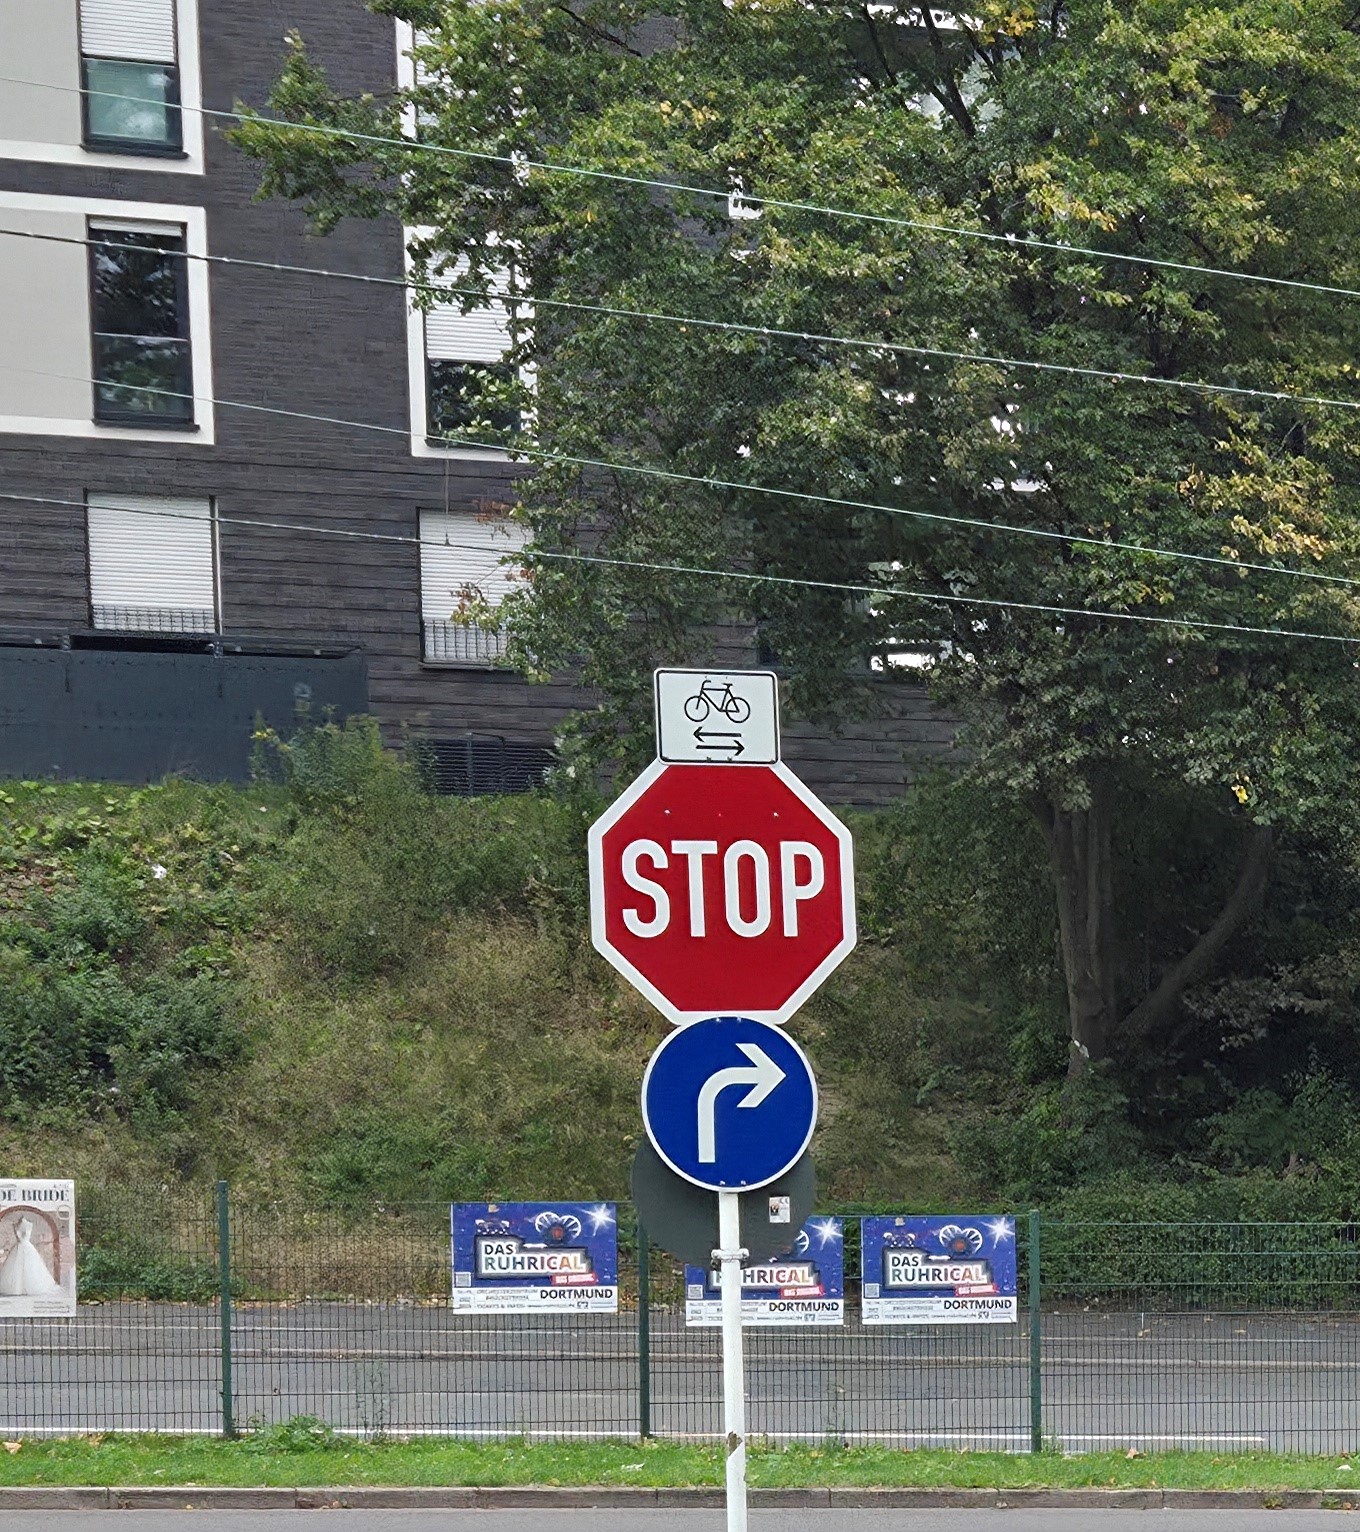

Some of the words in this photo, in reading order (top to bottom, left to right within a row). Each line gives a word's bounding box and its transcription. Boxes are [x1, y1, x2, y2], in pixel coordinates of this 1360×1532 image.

[621, 839, 826, 938] STOP
[22, 1189, 70, 1201] BRIDE
[484, 1244, 514, 1255] DAS
[484, 1256, 584, 1270] RUHRICAL
[891, 1256, 919, 1267] DAS
[892, 1268, 986, 1282] RUHRICAL
[540, 1290, 613, 1299] DORTMUND
[769, 1302, 840, 1312] DORTMUND
[943, 1300, 1012, 1310] DORTMUND
